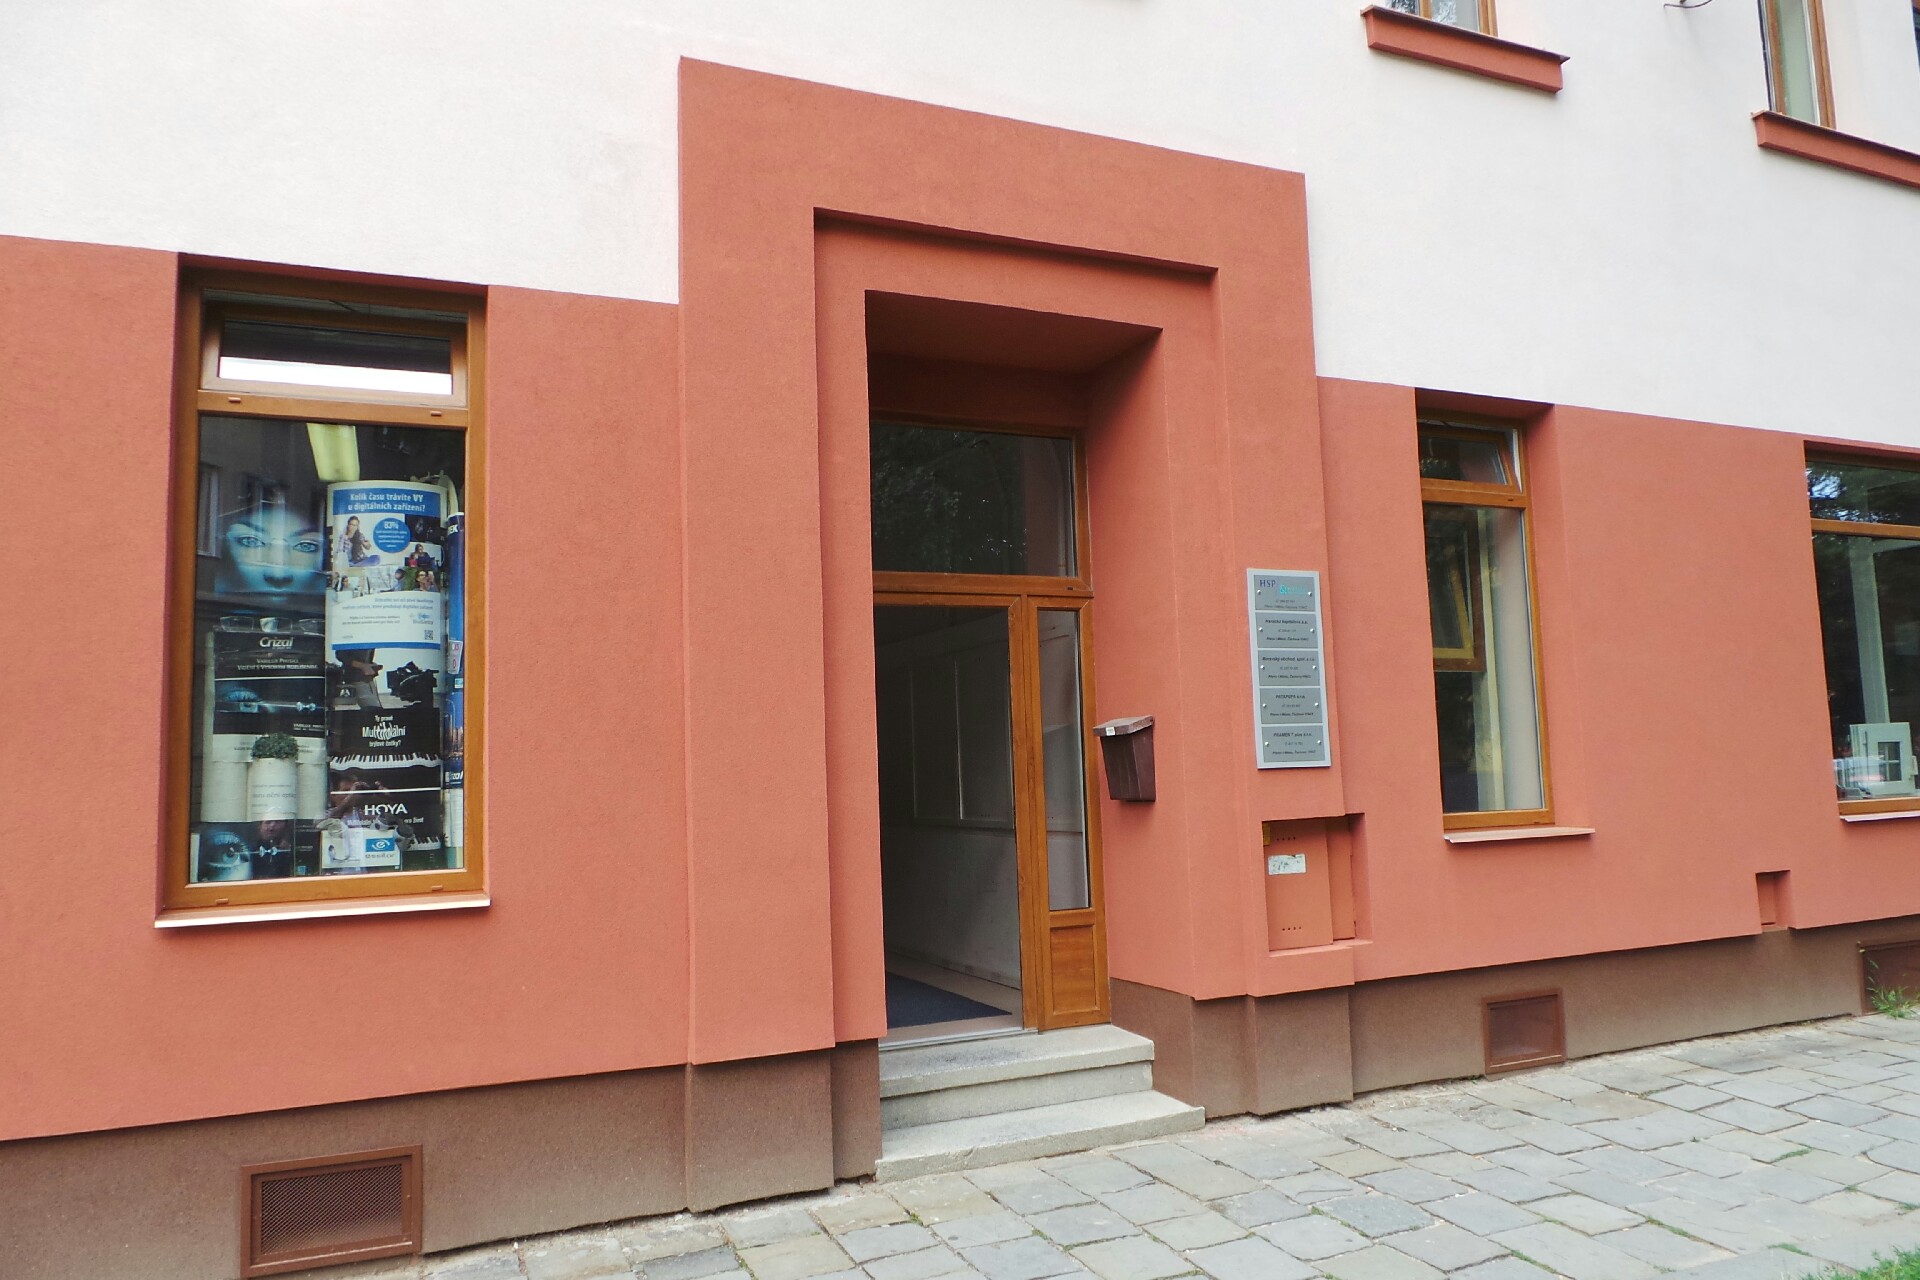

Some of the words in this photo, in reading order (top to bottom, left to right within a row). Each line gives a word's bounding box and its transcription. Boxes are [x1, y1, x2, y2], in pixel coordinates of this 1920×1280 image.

[350, 493, 367, 501] Kolik
[368, 492, 385, 501] času
[412, 494, 423, 502] VY
[1259, 579, 1276, 588] HSP
[259, 636, 294, 647] Crizal
[364, 804, 408, 816] HOYA
